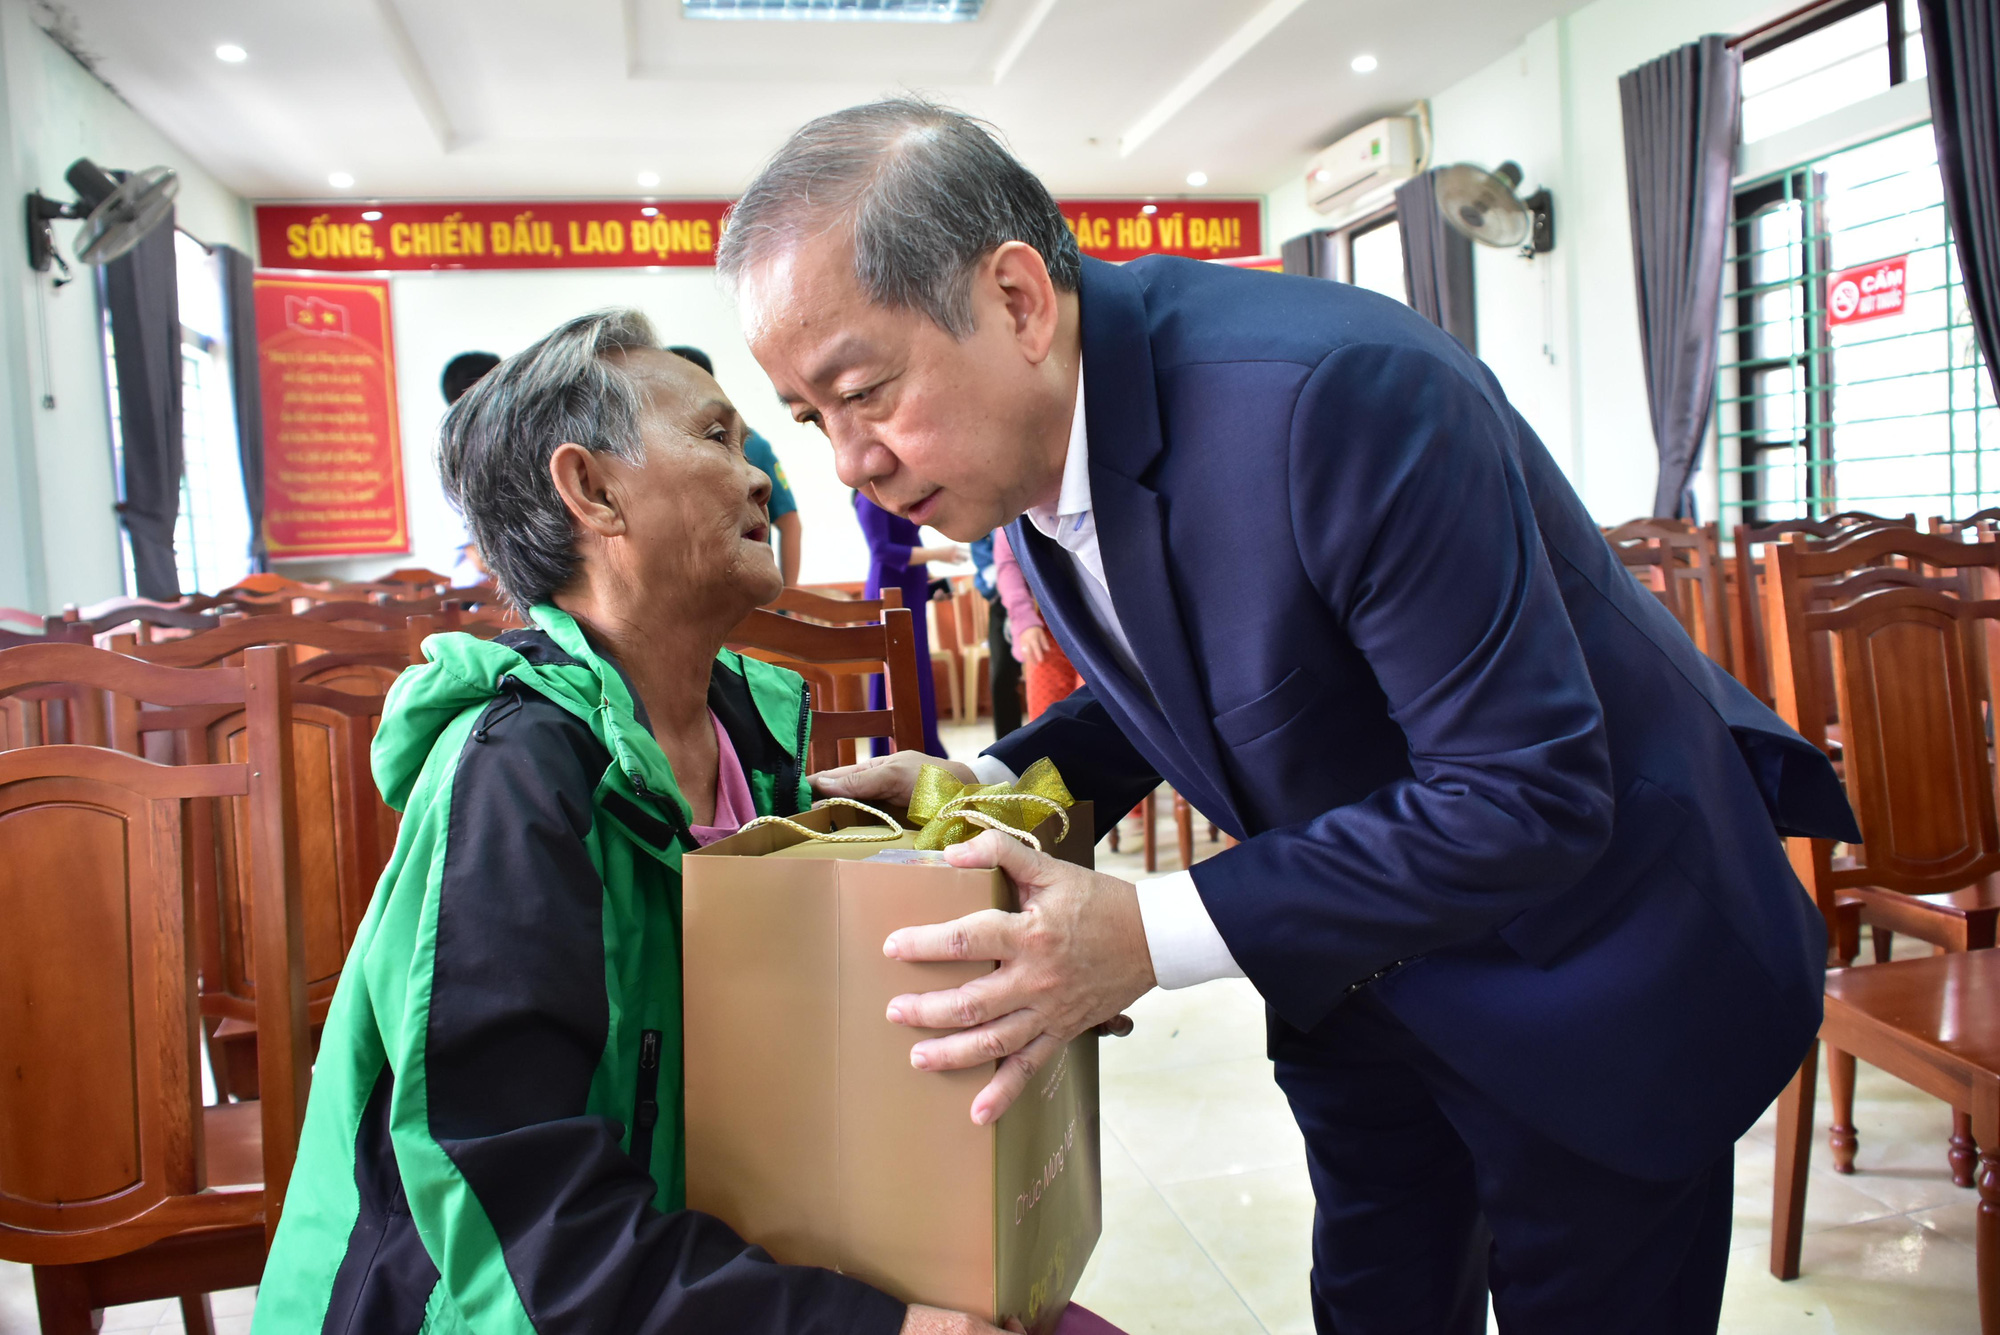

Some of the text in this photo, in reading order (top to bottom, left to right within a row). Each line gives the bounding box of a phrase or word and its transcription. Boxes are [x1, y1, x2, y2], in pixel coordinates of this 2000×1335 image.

[286, 213, 385, 261] SỐNG,
[389, 211, 484, 256] CHIẾN
[490, 210, 563, 259] ĐẤU,
[568, 219, 626, 254] LAO
[631, 213, 713, 260] ĐỘNG
[1117, 210, 1153, 248] HỒ
[1157, 211, 1186, 249] VĨ
[1189, 217, 1242, 254] ĐẠI!
[1015, 1177, 1042, 1226] Chúc
